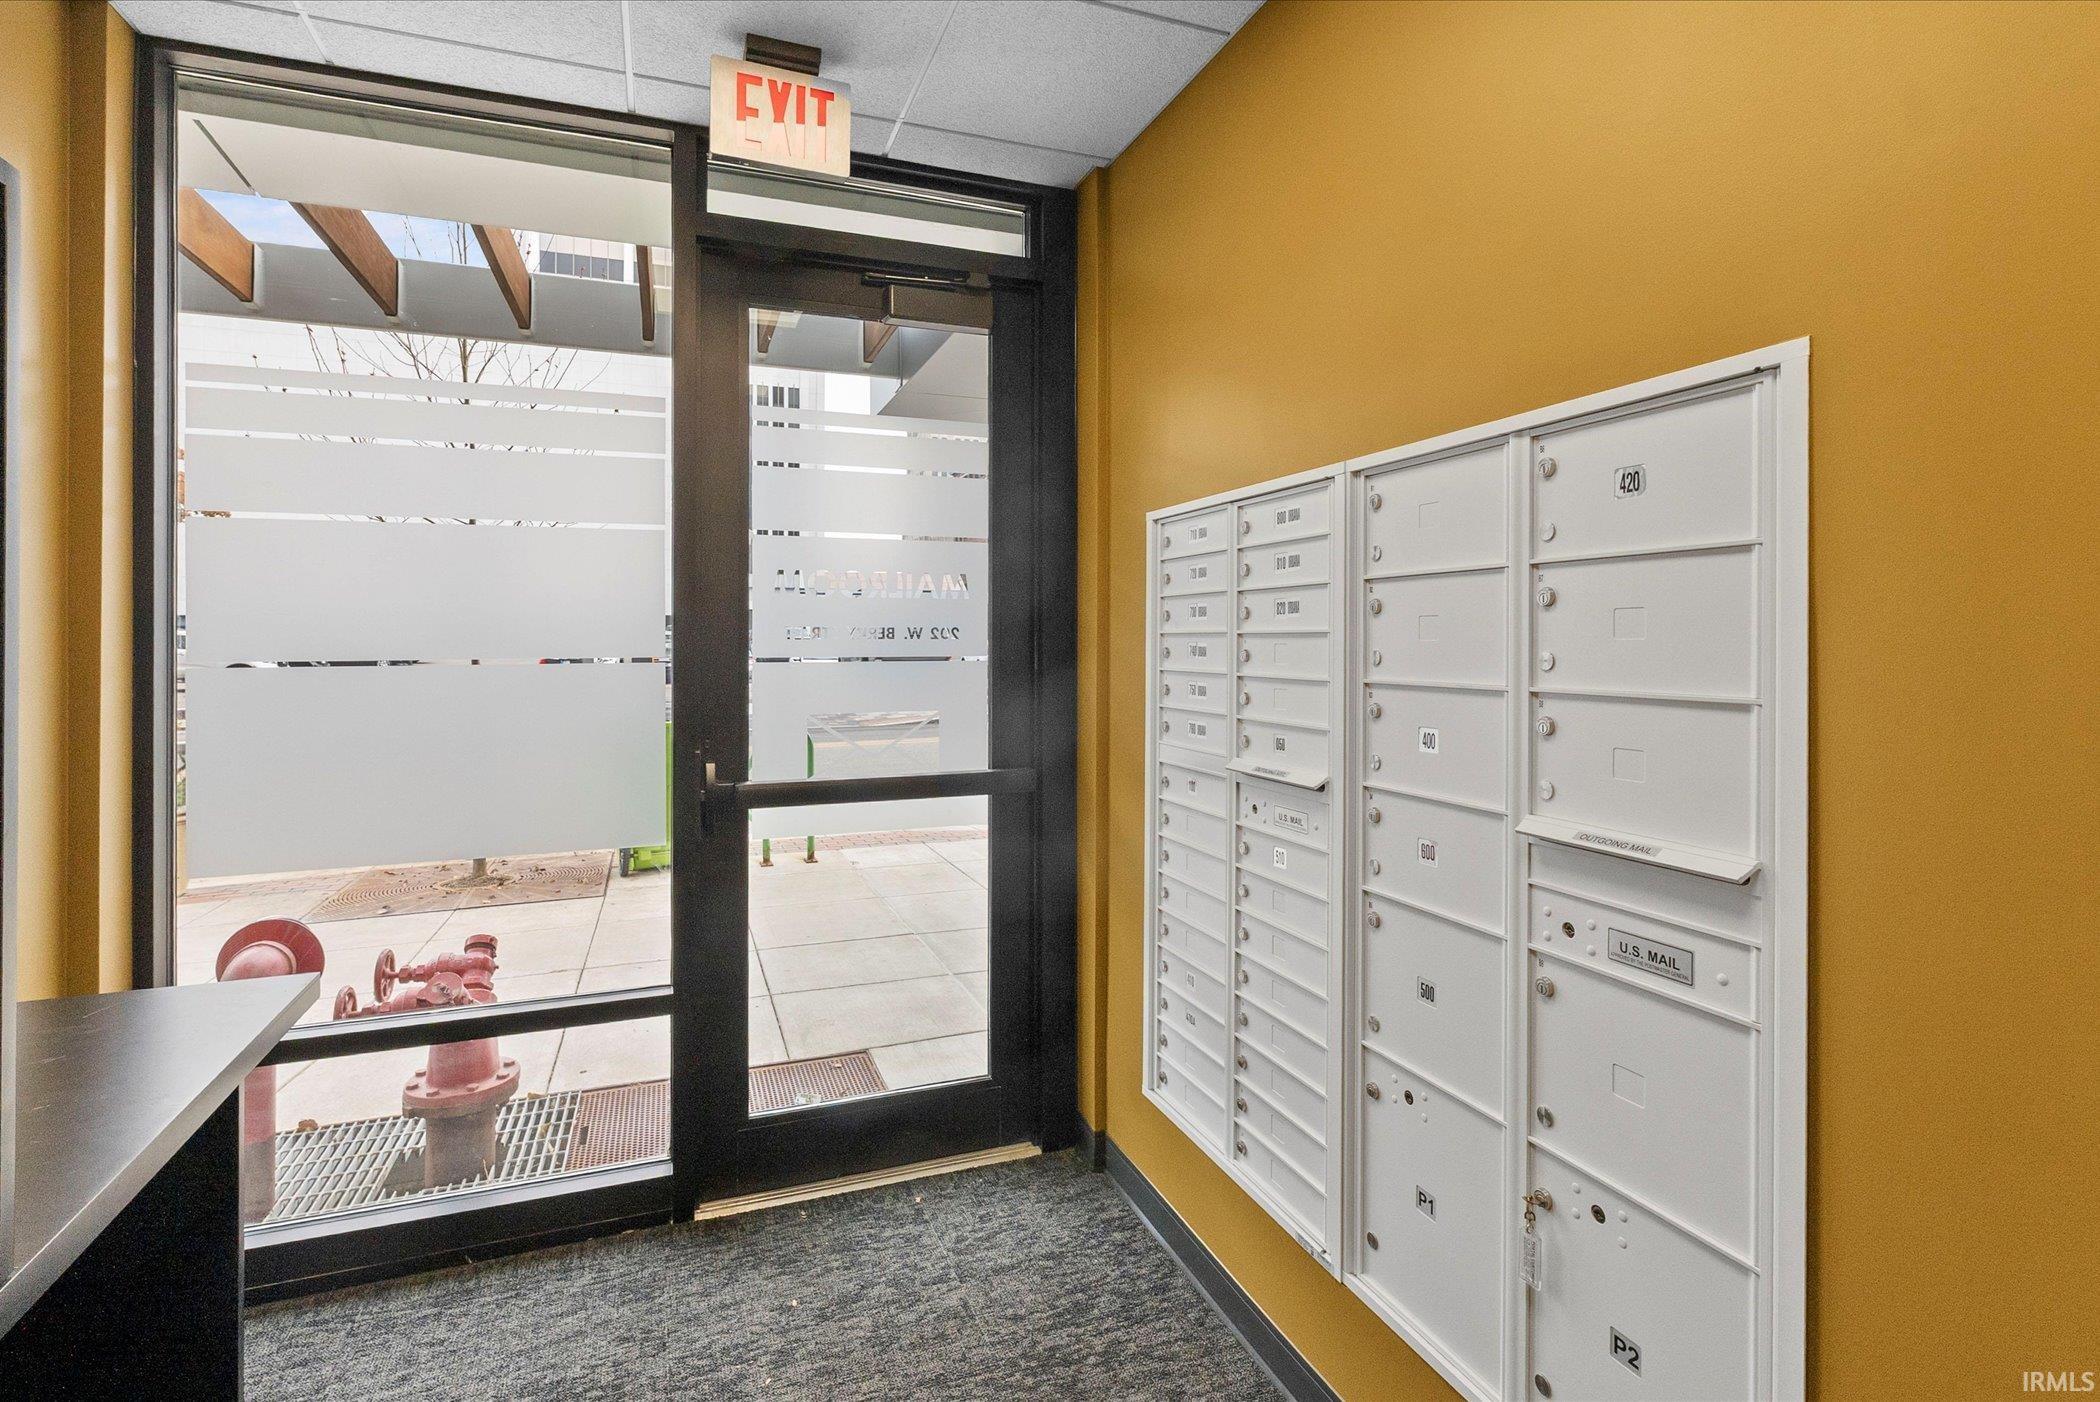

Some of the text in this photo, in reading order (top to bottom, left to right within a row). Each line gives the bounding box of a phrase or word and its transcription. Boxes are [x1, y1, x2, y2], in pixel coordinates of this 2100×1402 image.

[736, 72, 835, 163] EXIT
[1619, 471, 1640, 494] 420
[1422, 732, 1436, 750] 400
[1421, 843, 1435, 861] 600
[1580, 833, 1653, 855] OUTGOING MAIL
[1620, 941, 1681, 971] U.S. MAIL
[1420, 982, 1434, 1003] 500
[1419, 1190, 1433, 1215] P1
[1613, 1334, 1640, 1371] P2
